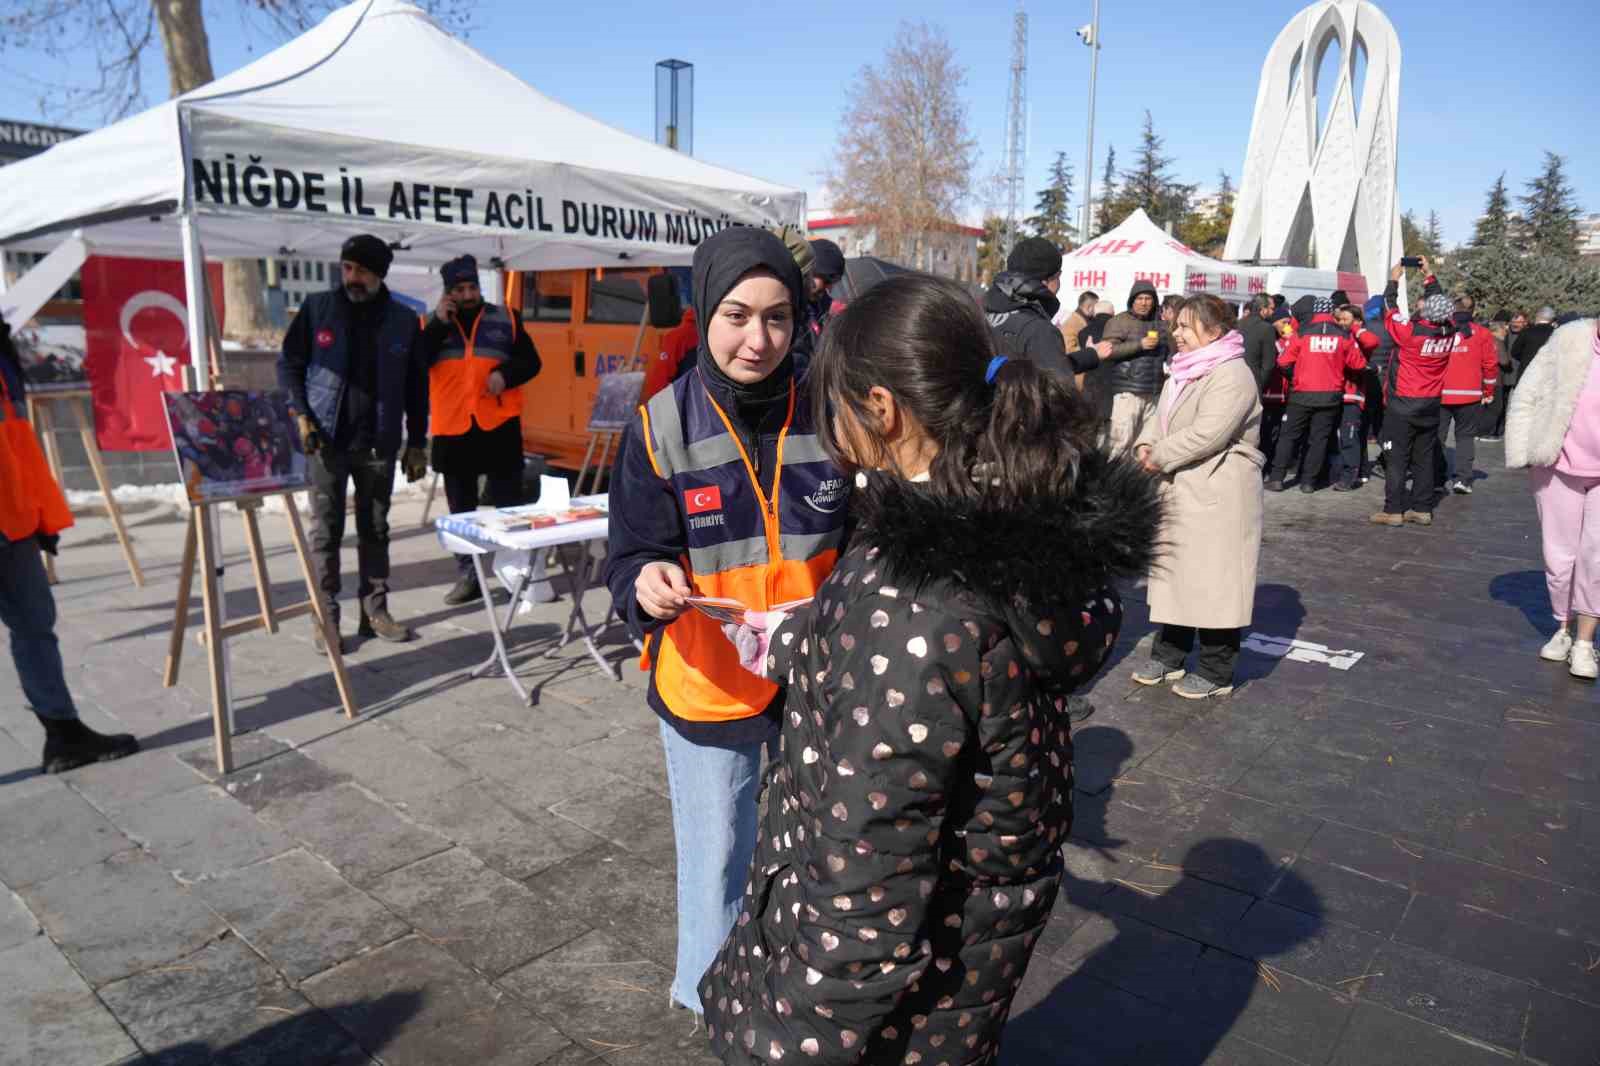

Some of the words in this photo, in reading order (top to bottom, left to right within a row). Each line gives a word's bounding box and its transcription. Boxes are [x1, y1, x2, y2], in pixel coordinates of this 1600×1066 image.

[192, 153, 328, 213] NİĞDE
[339, 167, 376, 215] İL
[388, 181, 473, 225] AFET
[484, 188, 553, 232] ACİL
[562, 199, 657, 243] DURUM
